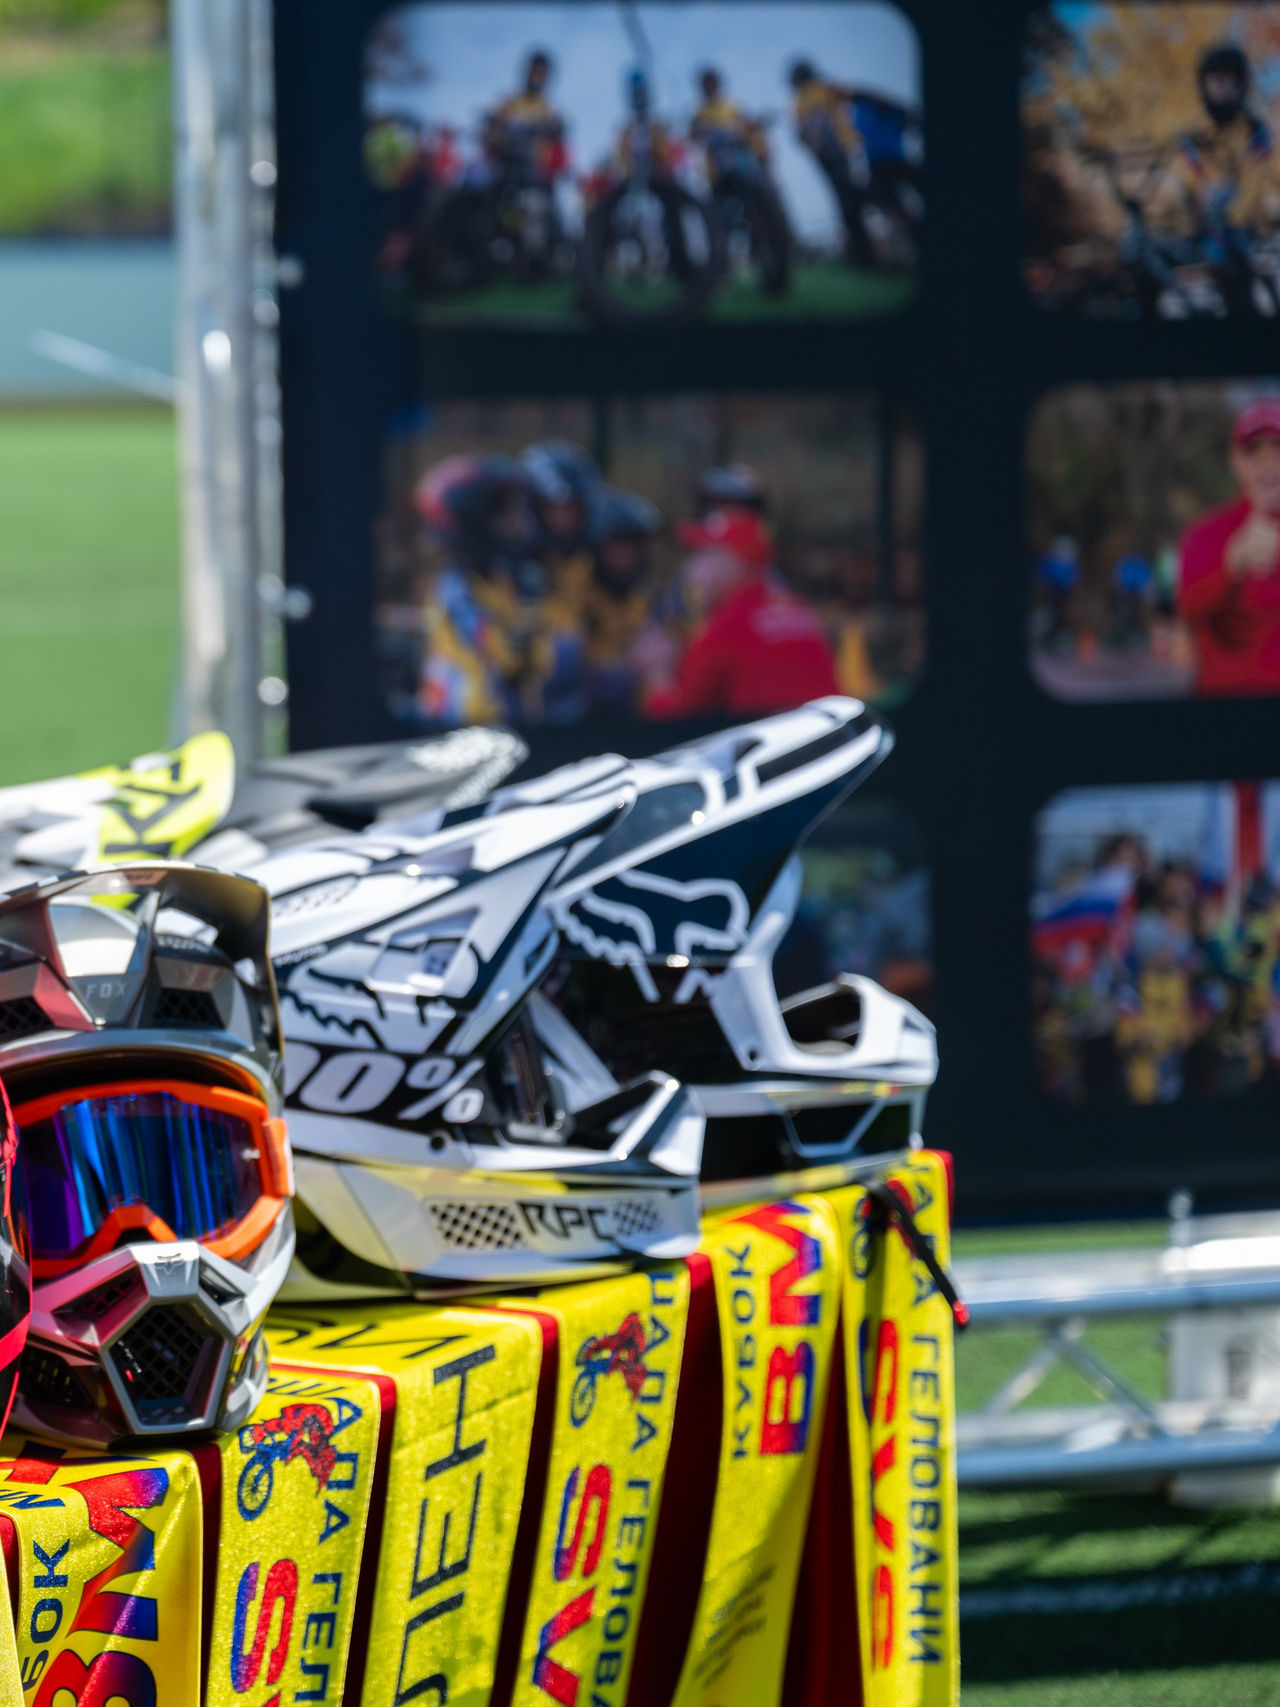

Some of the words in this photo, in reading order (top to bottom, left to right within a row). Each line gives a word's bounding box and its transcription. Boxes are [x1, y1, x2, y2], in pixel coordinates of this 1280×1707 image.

[86, 981, 127, 999] FOX
[520, 1203, 615, 1241] RPC
[724, 1243, 758, 1461] КУБОК
[908, 1334, 943, 1668] ГЕЛОВАНИ
[294, 1571, 344, 1707] ГЕЛ
[587, 1477, 652, 1707] ГЕЛОВ
